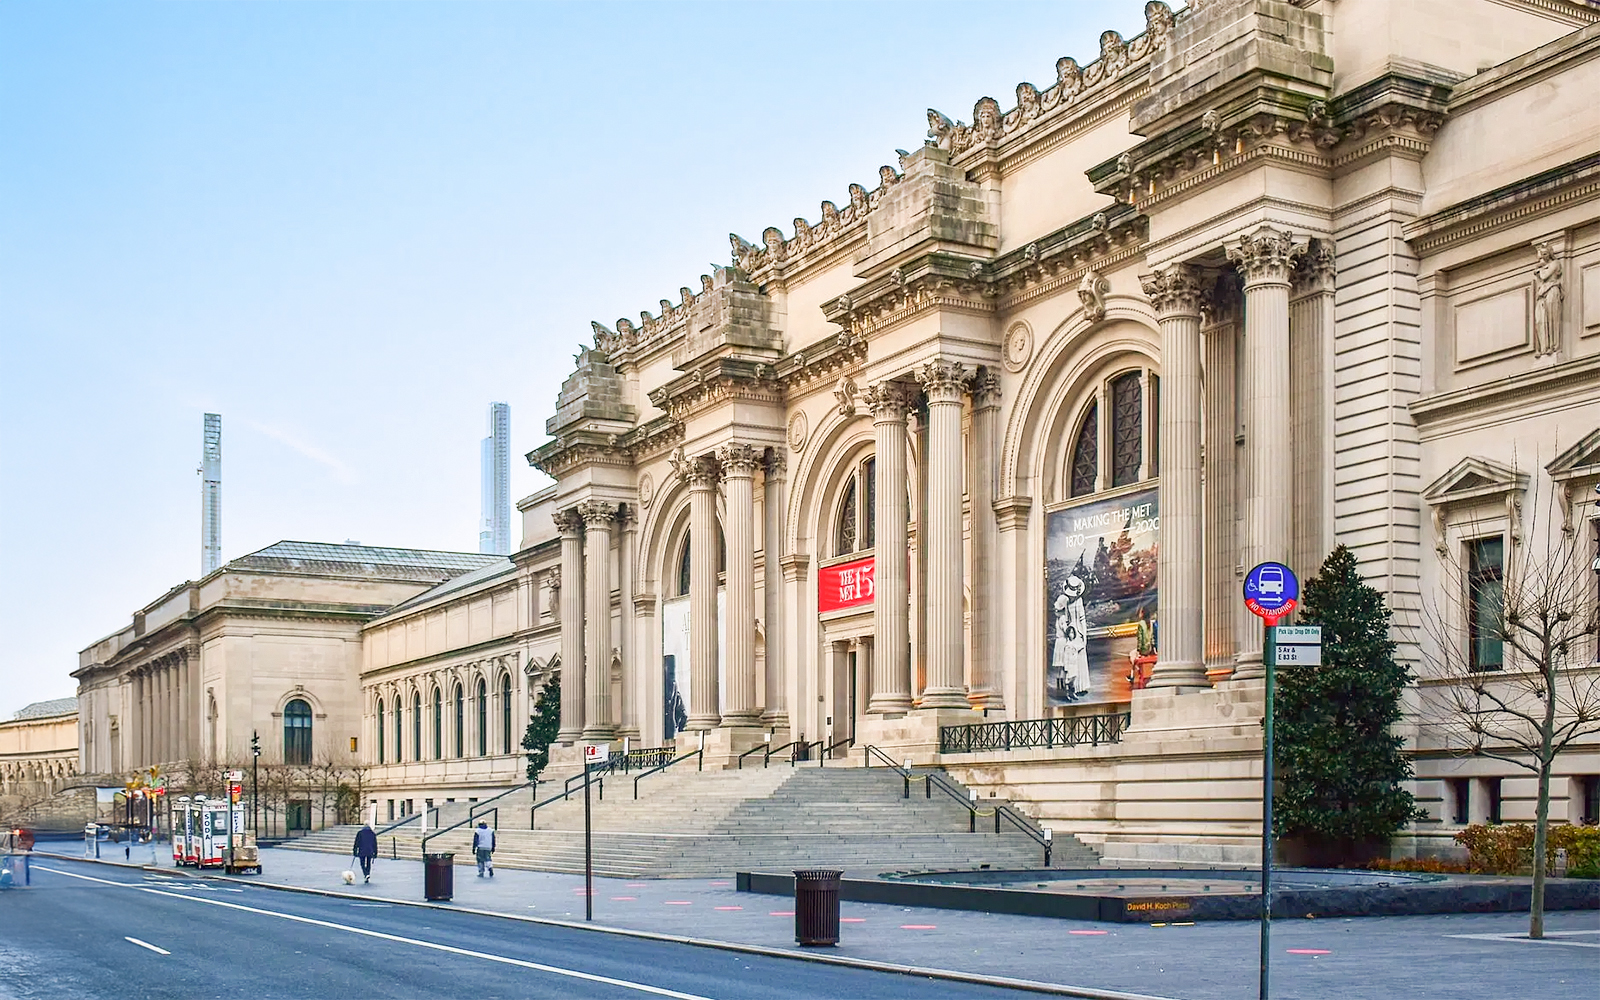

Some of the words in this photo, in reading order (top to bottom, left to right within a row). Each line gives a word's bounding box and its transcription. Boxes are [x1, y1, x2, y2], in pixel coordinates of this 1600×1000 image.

[1073, 513, 1110, 532] MAKING
[1111, 508, 1130, 523] THE
[1132, 503, 1152, 519] MET
[1066, 534, 1085, 548] 1870
[839, 569, 855, 586] THE
[839, 585, 855, 602] MET
[1249, 602, 1259, 611] NO
[1260, 602, 1292, 616] STANDING
[1127, 902, 1146, 911] David
[1146, 902, 1155, 910] H.
[1155, 901, 1171, 910] Koch
